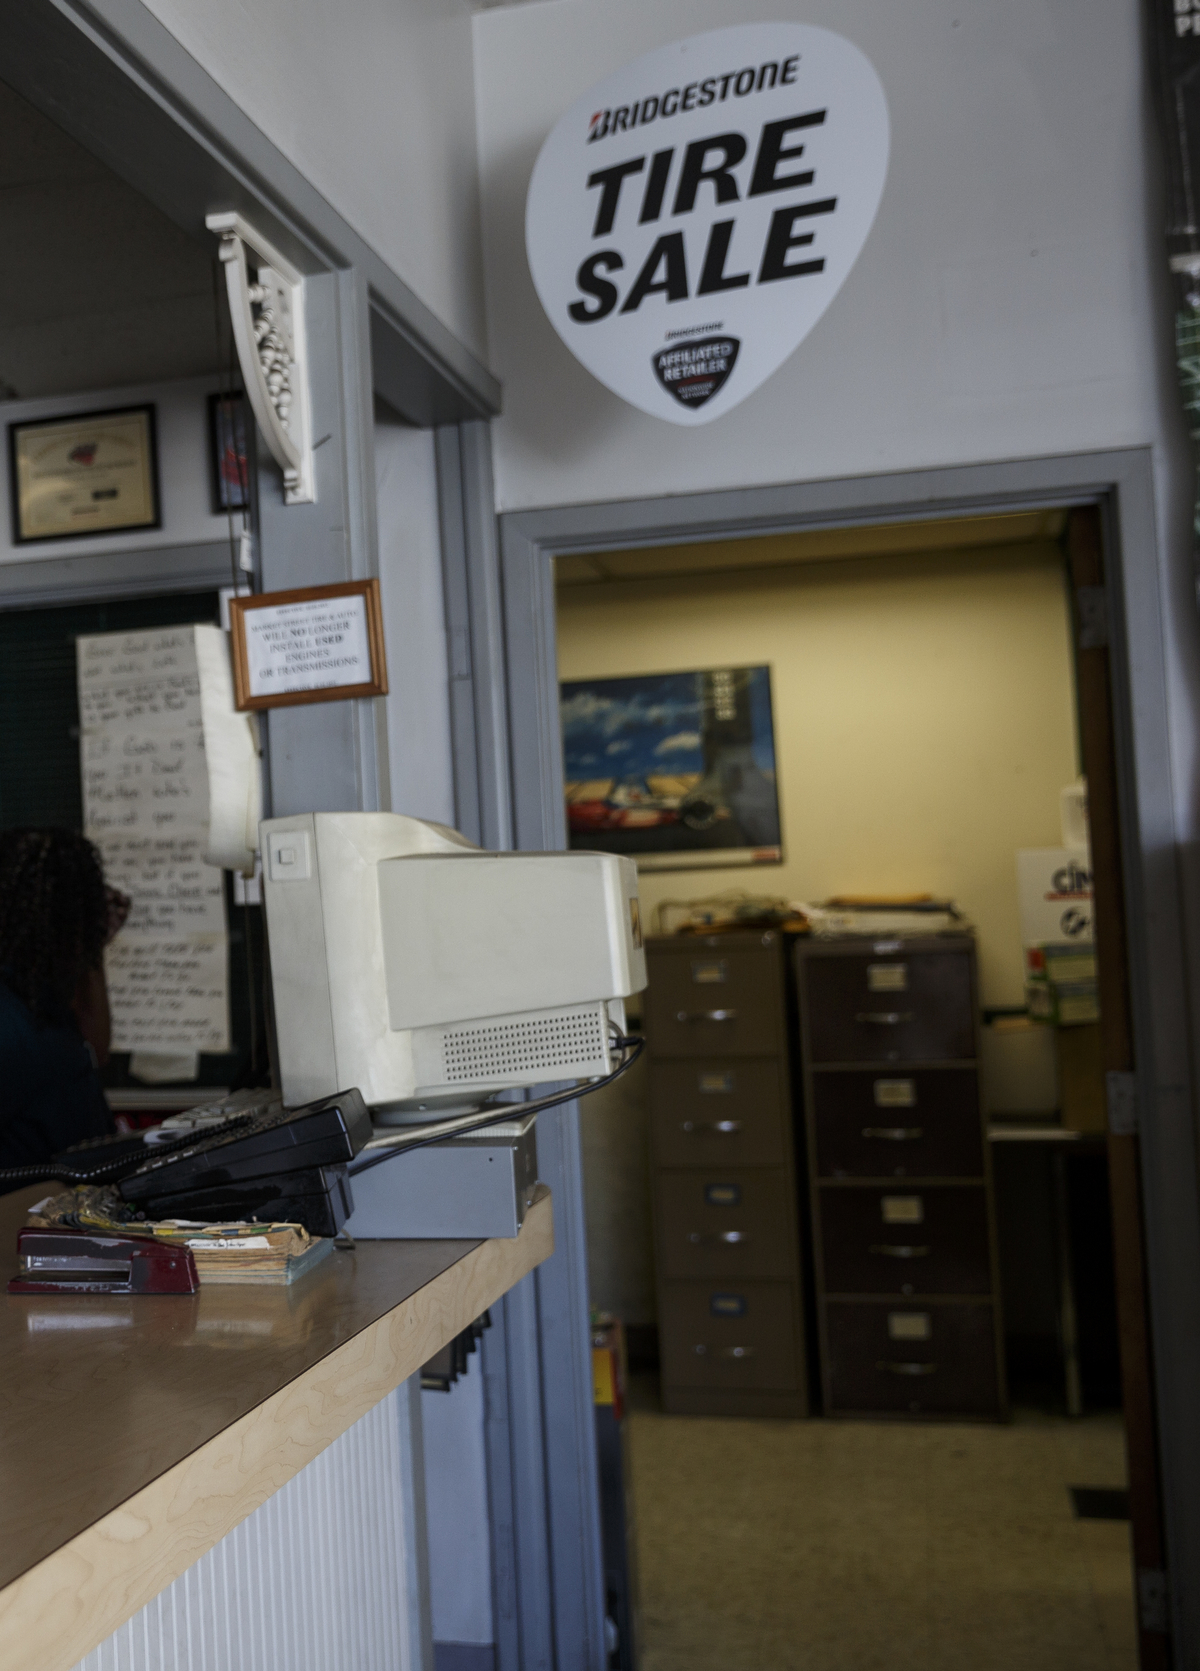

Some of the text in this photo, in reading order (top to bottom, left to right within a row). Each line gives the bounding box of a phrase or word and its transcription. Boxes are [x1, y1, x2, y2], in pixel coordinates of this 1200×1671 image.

[586, 54, 802, 144] BRIDGESTONE
[585, 108, 828, 238] TIRE
[567, 196, 839, 325] SALE
[658, 342, 733, 369] AFFILIATED
[663, 359, 728, 382] RETAILER
[262, 620, 350, 642] WILL NO LONGER
[270, 634, 343, 654] INSTALL USED
[285, 648, 331, 663] ENGINES
[259, 656, 358, 679] OR TRANSMISSIONS
